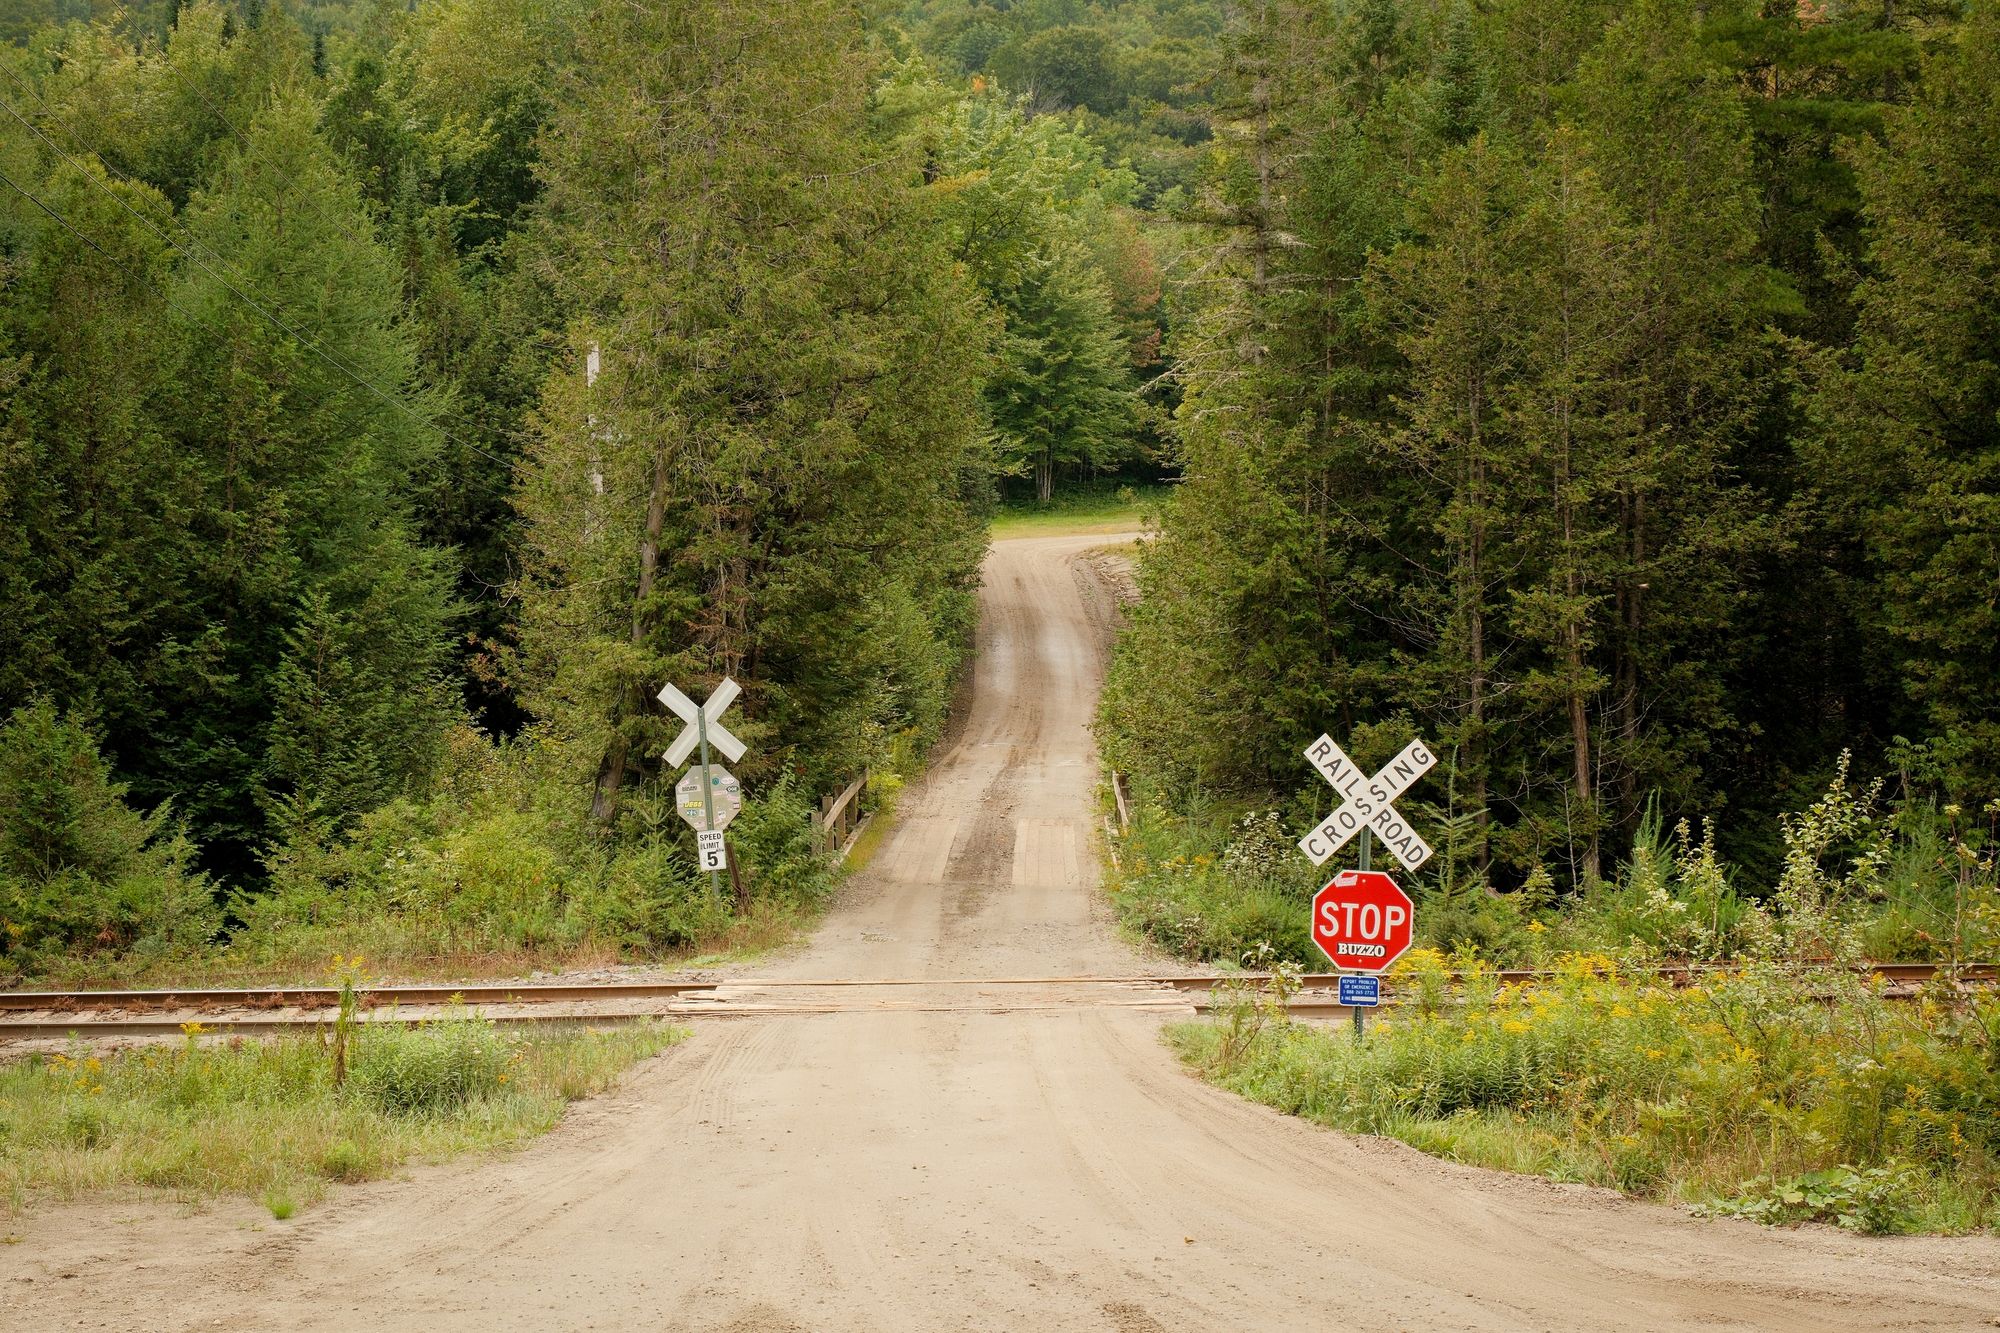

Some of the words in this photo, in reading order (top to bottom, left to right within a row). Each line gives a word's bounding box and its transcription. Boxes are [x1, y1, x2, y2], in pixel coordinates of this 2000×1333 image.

[1308, 745, 1430, 858] CROSSING
[1311, 741, 1361, 799] RAIL
[1372, 808, 1424, 865] ROAD
[699, 833, 722, 841] SPEED
[702, 841, 719, 850] LIMIT
[707, 851, 719, 867] 5
[1319, 901, 1406, 941] STOP
[1337, 943, 1386, 957] BUZZO
